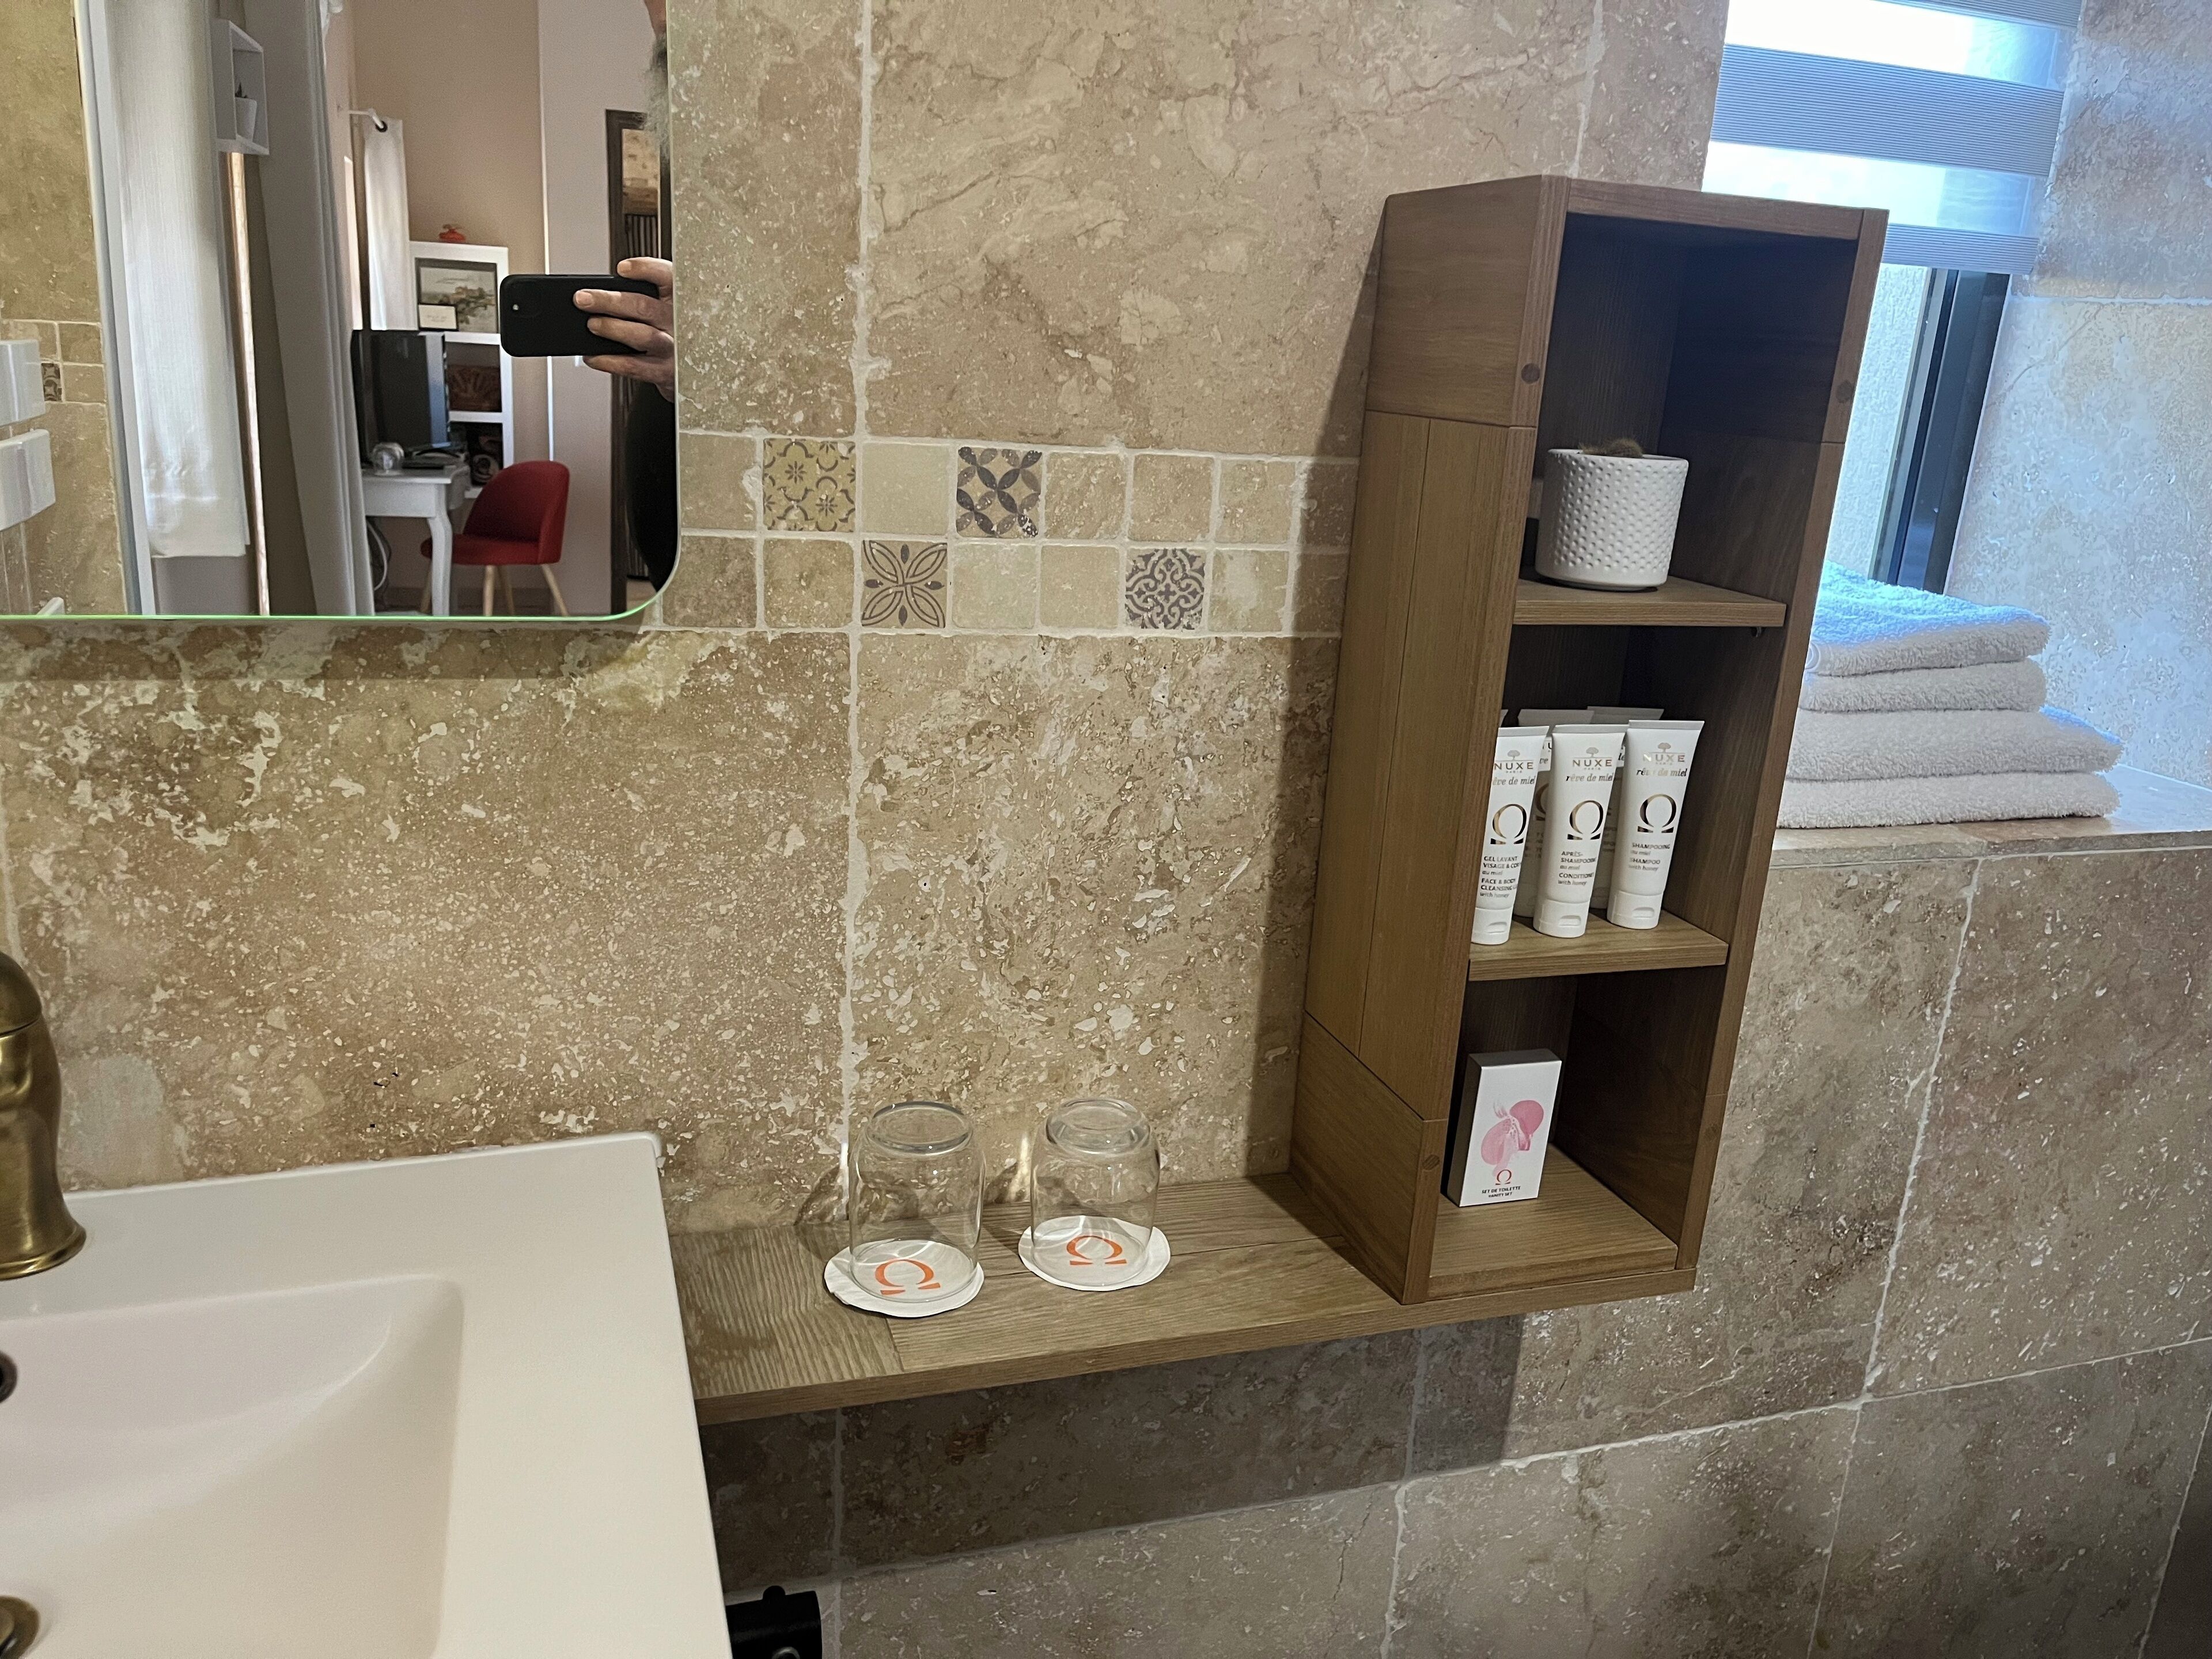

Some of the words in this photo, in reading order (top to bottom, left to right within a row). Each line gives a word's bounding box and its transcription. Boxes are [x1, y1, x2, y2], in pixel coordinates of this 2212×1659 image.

[1643, 753, 1685, 762] NUXE
[1494, 762, 1533, 770] NUXE
[1670, 768, 1688, 777] miel
[1492, 777, 1506, 785] êve
[1509, 777, 1518, 785] de
[1521, 775, 1536, 785] miel
[1566, 774, 1585, 782] rêve
[1586, 773, 1597, 782] de
